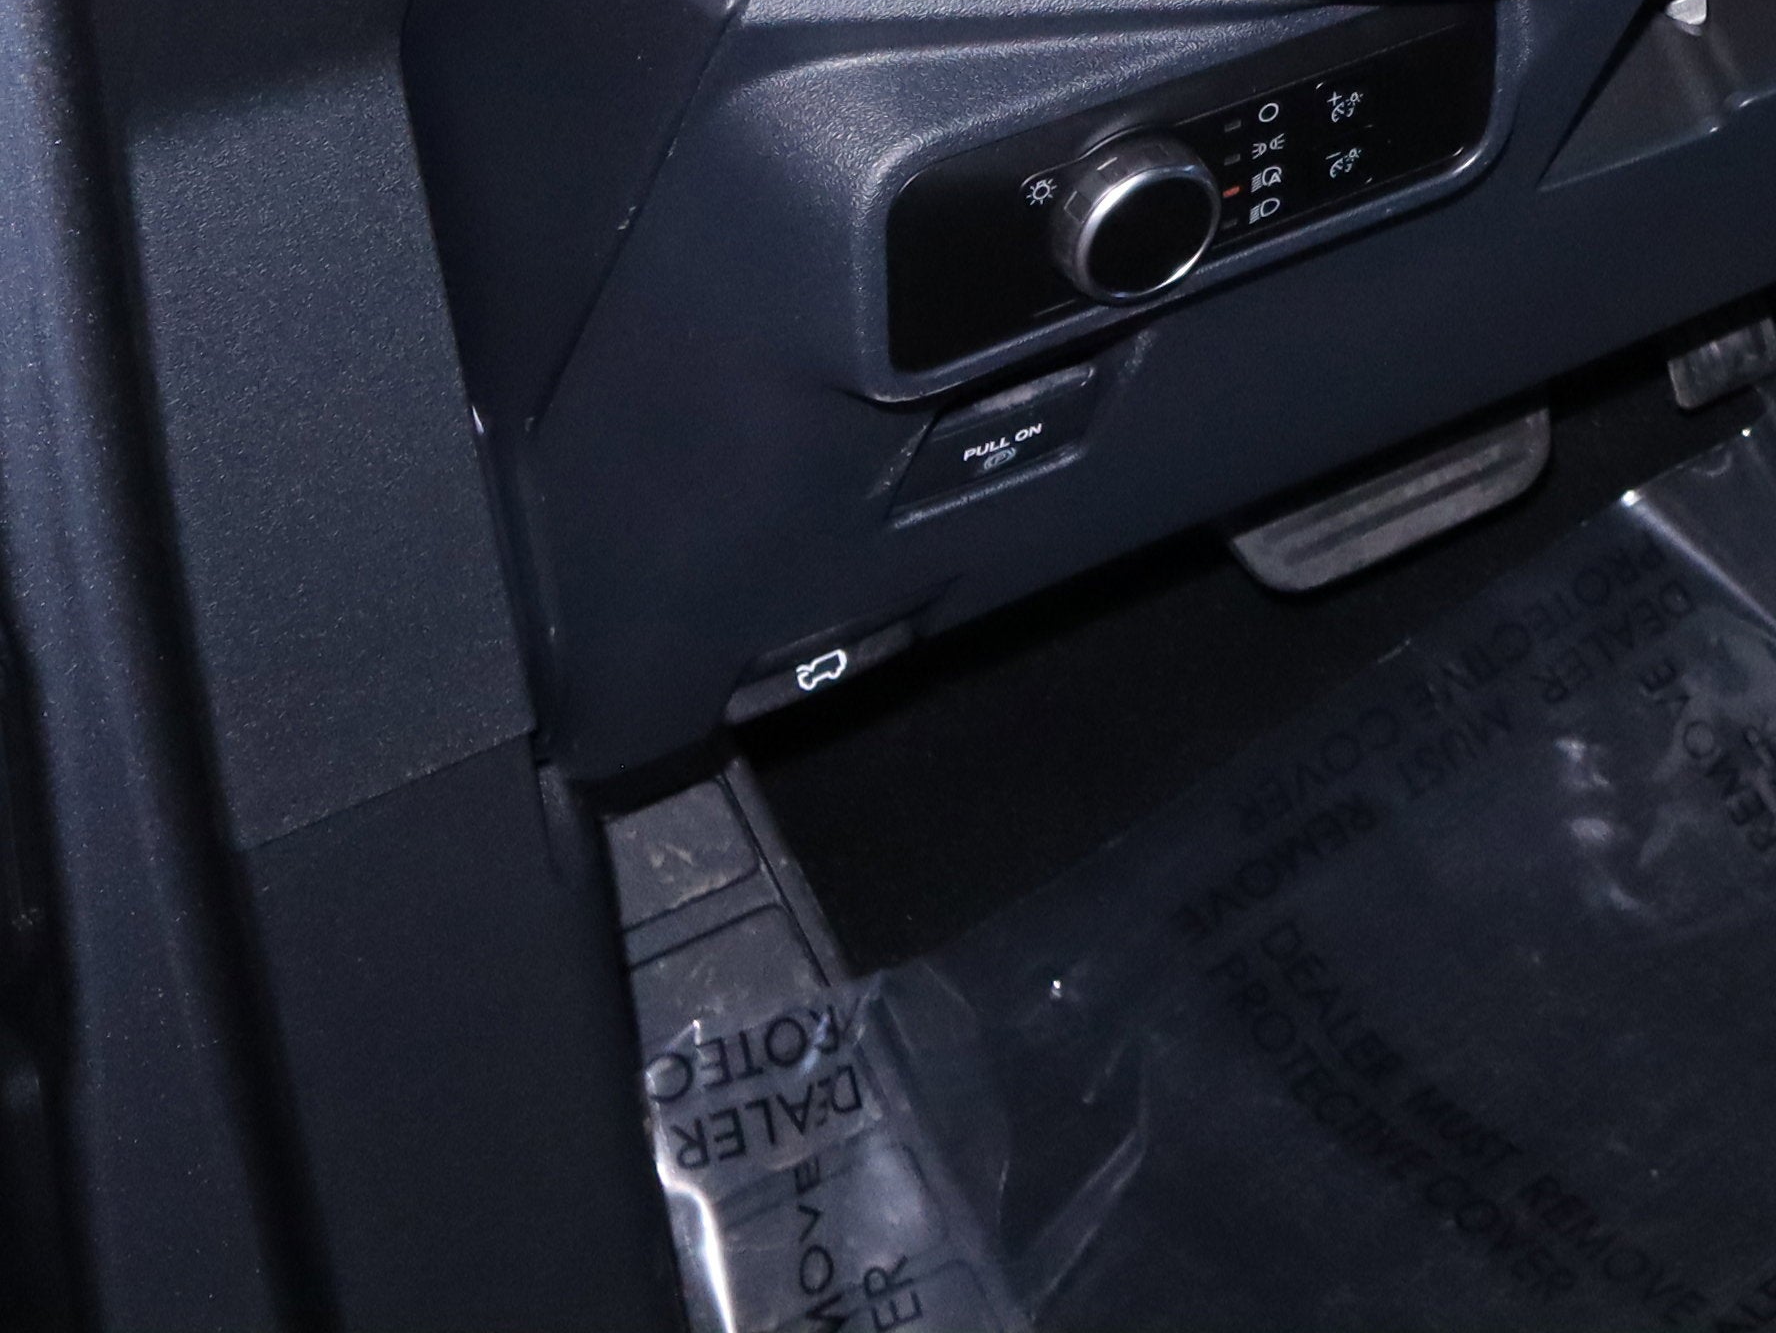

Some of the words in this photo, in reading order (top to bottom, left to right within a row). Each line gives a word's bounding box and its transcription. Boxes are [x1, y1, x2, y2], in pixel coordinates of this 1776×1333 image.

[963, 437, 1011, 461] PULL
[1015, 423, 1042, 442] ON
[1205, 950, 1433, 1183] PROTECTIVE
[1423, 1171, 1579, 1304] COVER
[1258, 917, 1403, 1083] DEALER
[1404, 1083, 1524, 1170] MUST
[1517, 1171, 1711, 1327] REMOVE
